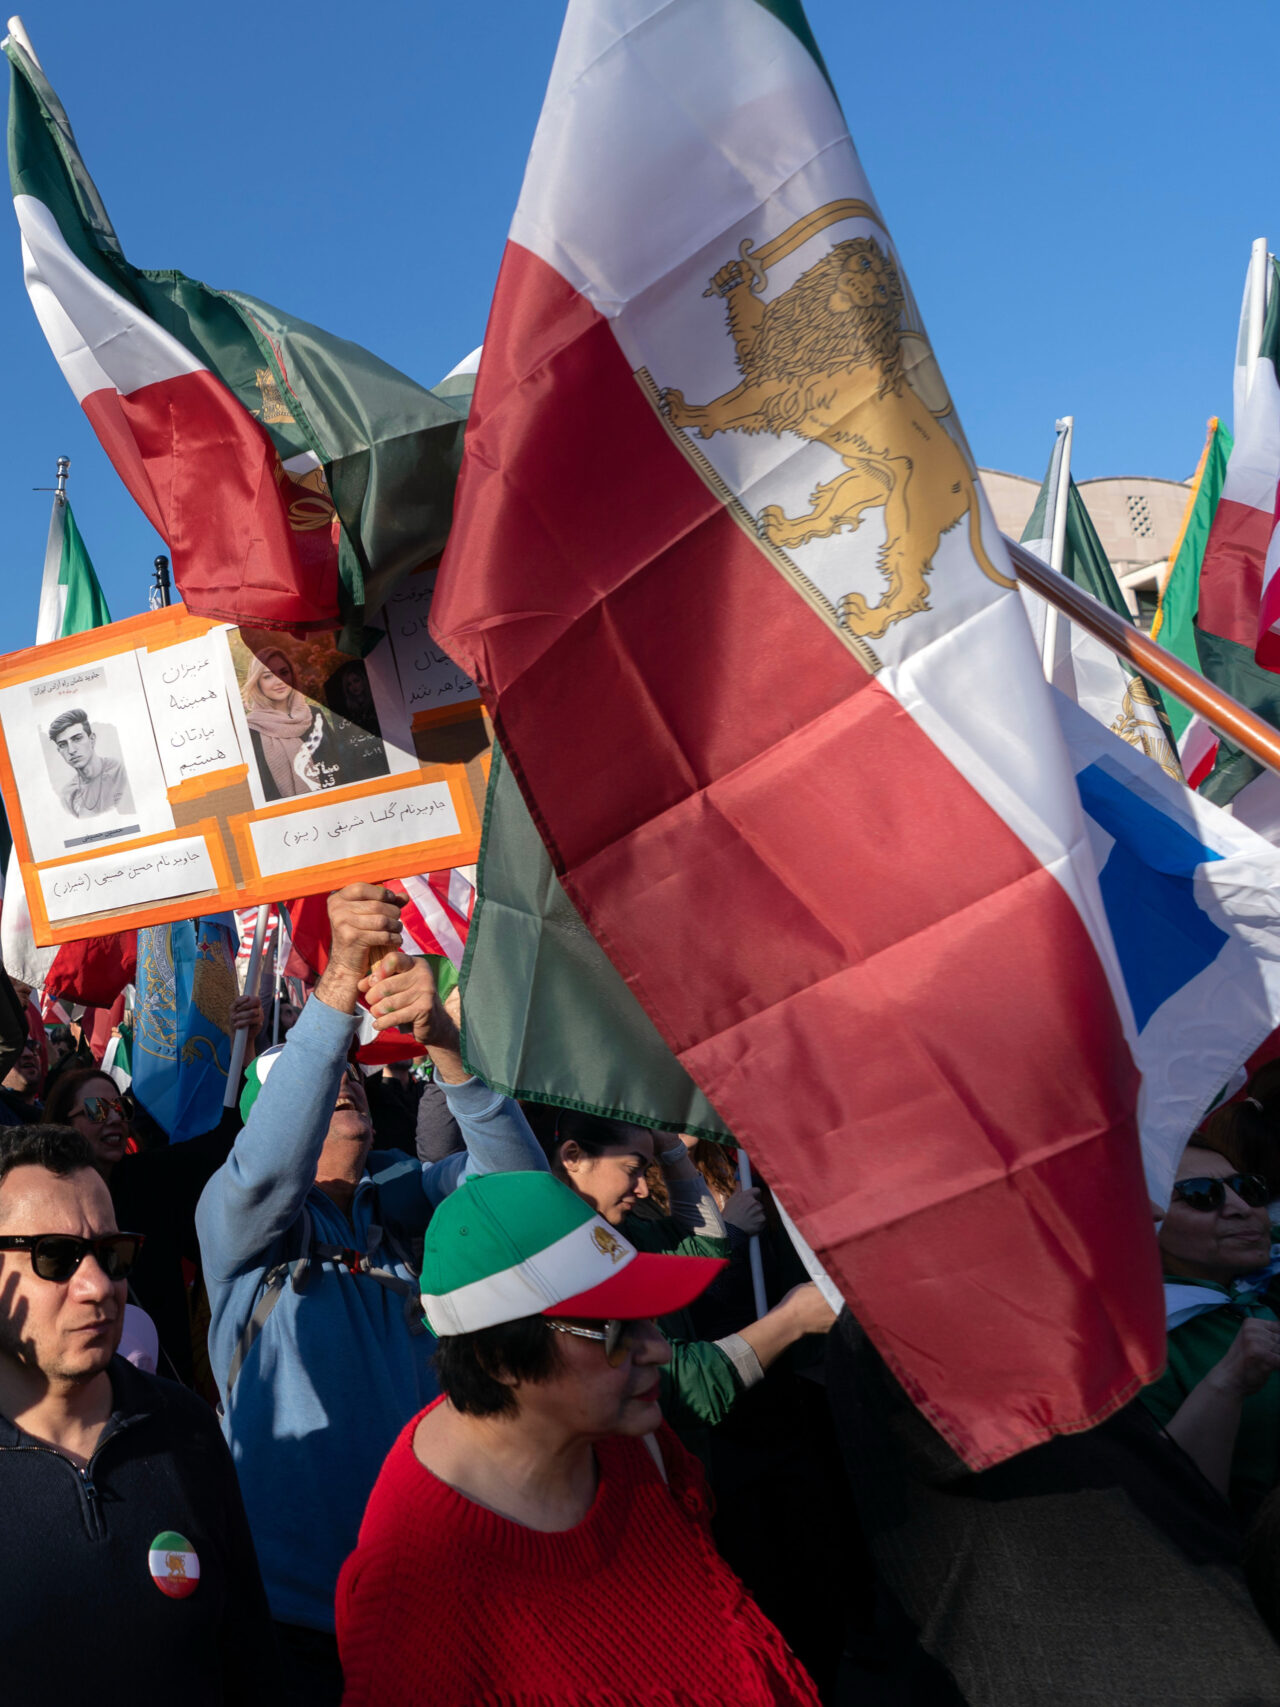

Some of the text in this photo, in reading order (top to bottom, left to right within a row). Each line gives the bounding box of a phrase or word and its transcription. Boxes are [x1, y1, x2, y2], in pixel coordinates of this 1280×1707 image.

[162, 659, 211, 684] عزیزان
[169, 689, 218, 711] همیشه
[179, 749, 227, 776] هستیم
[370, 802, 397, 824] گلسا
[327, 815, 365, 838] شریفی
[94, 870, 124, 886] حسینی
[128, 864, 153, 879] حسین
